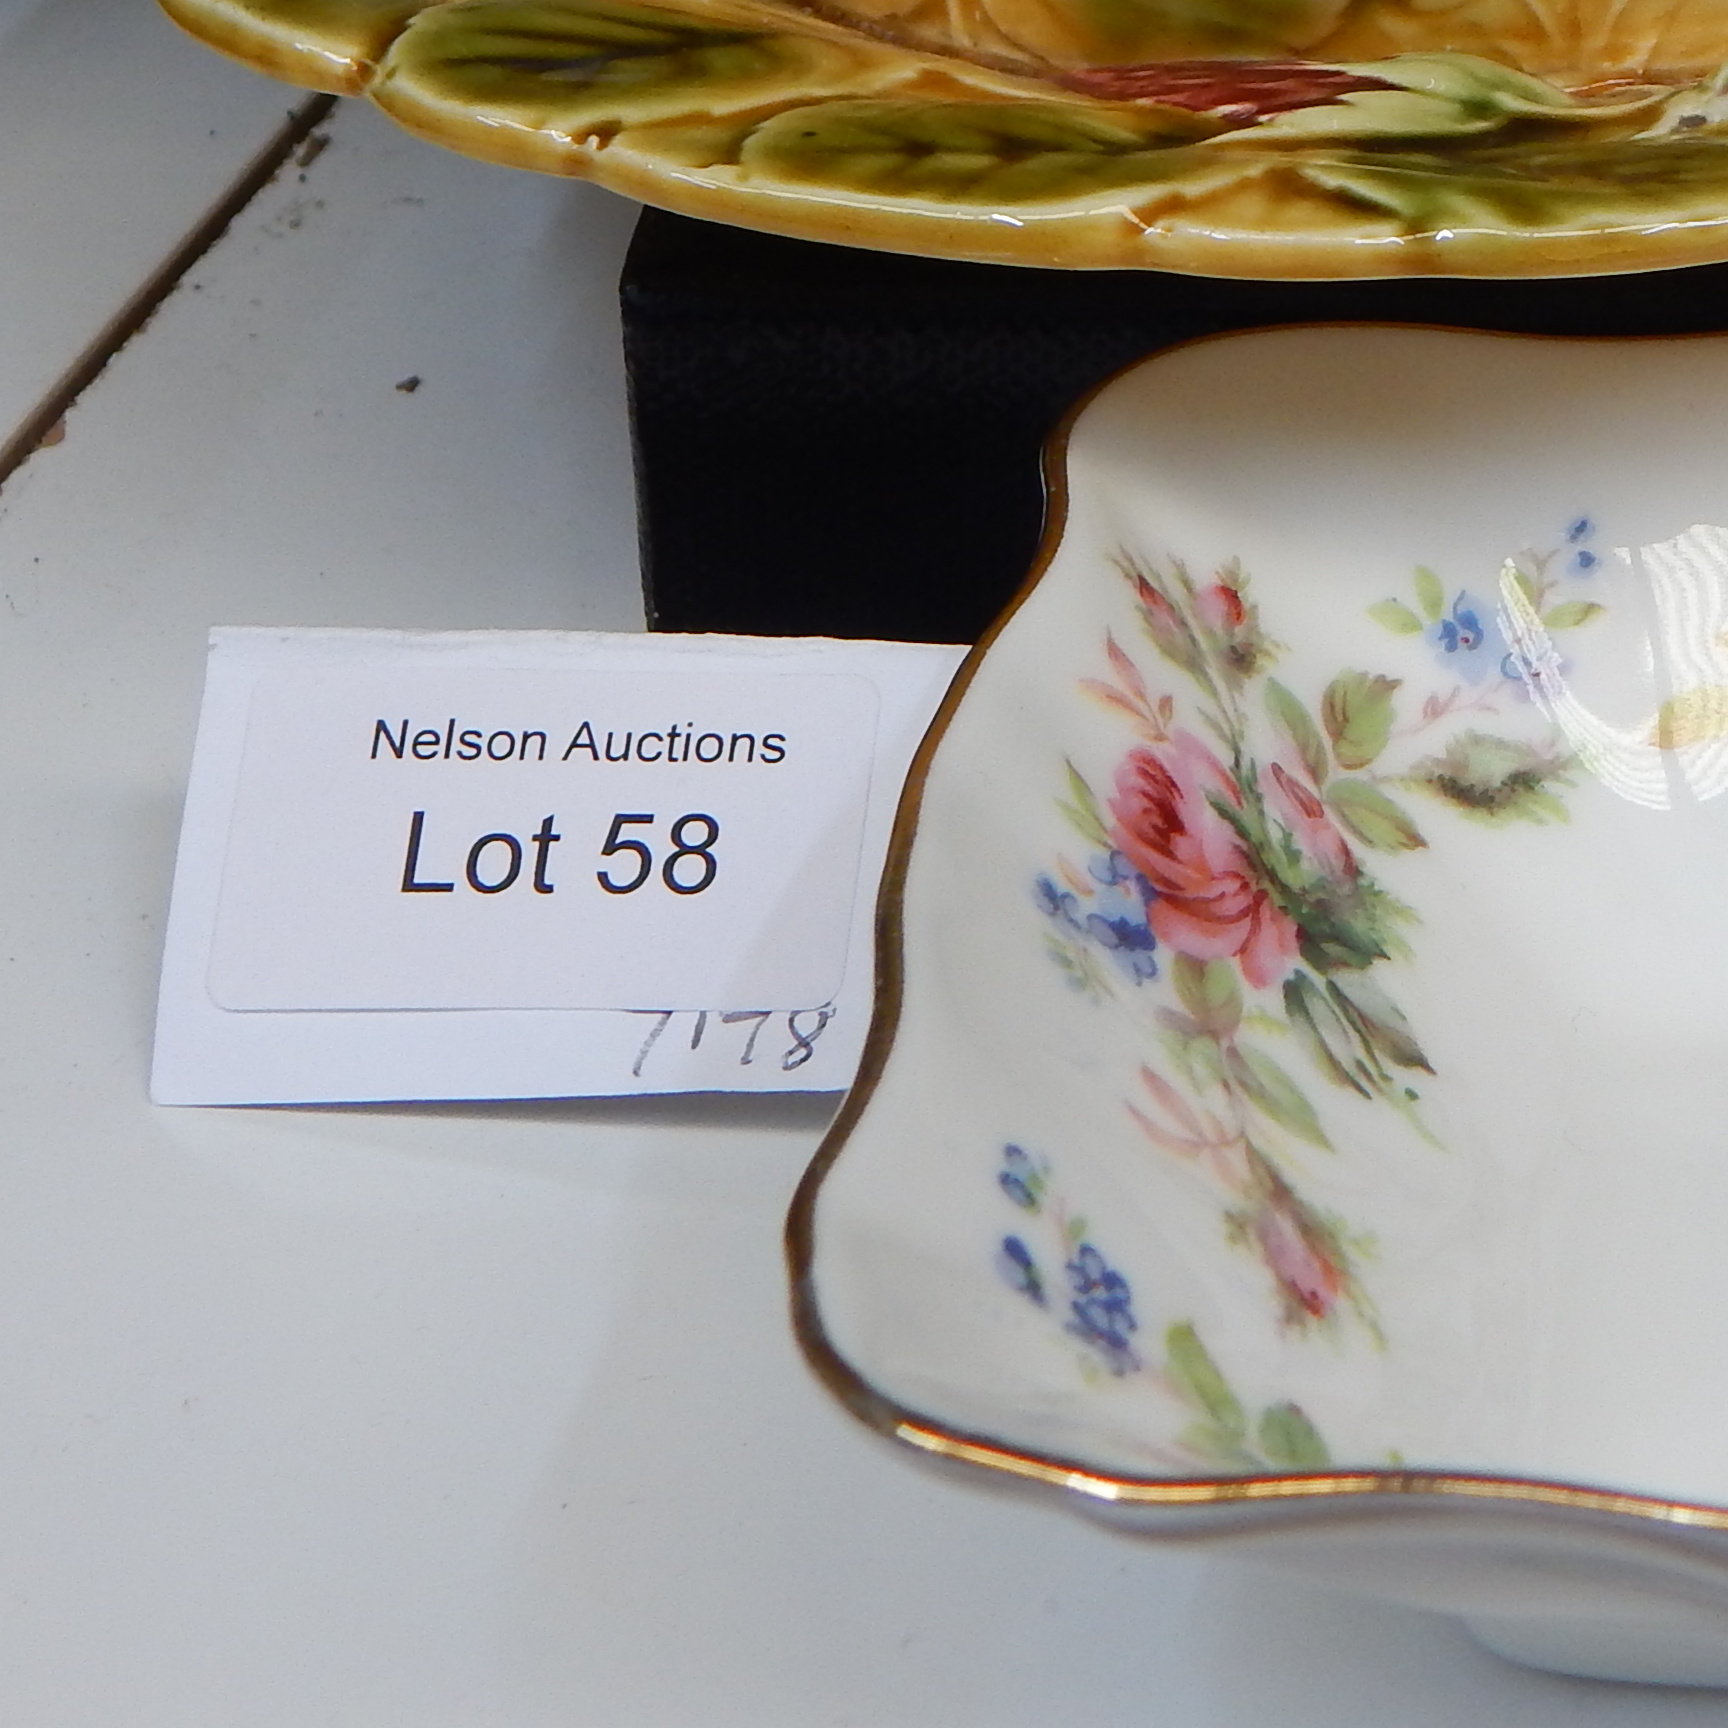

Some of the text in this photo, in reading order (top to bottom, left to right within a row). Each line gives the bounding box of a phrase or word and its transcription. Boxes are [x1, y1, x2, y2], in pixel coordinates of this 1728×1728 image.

[370, 718, 787, 764] Nelson Auctions
[401, 811, 720, 896] Lot 58
